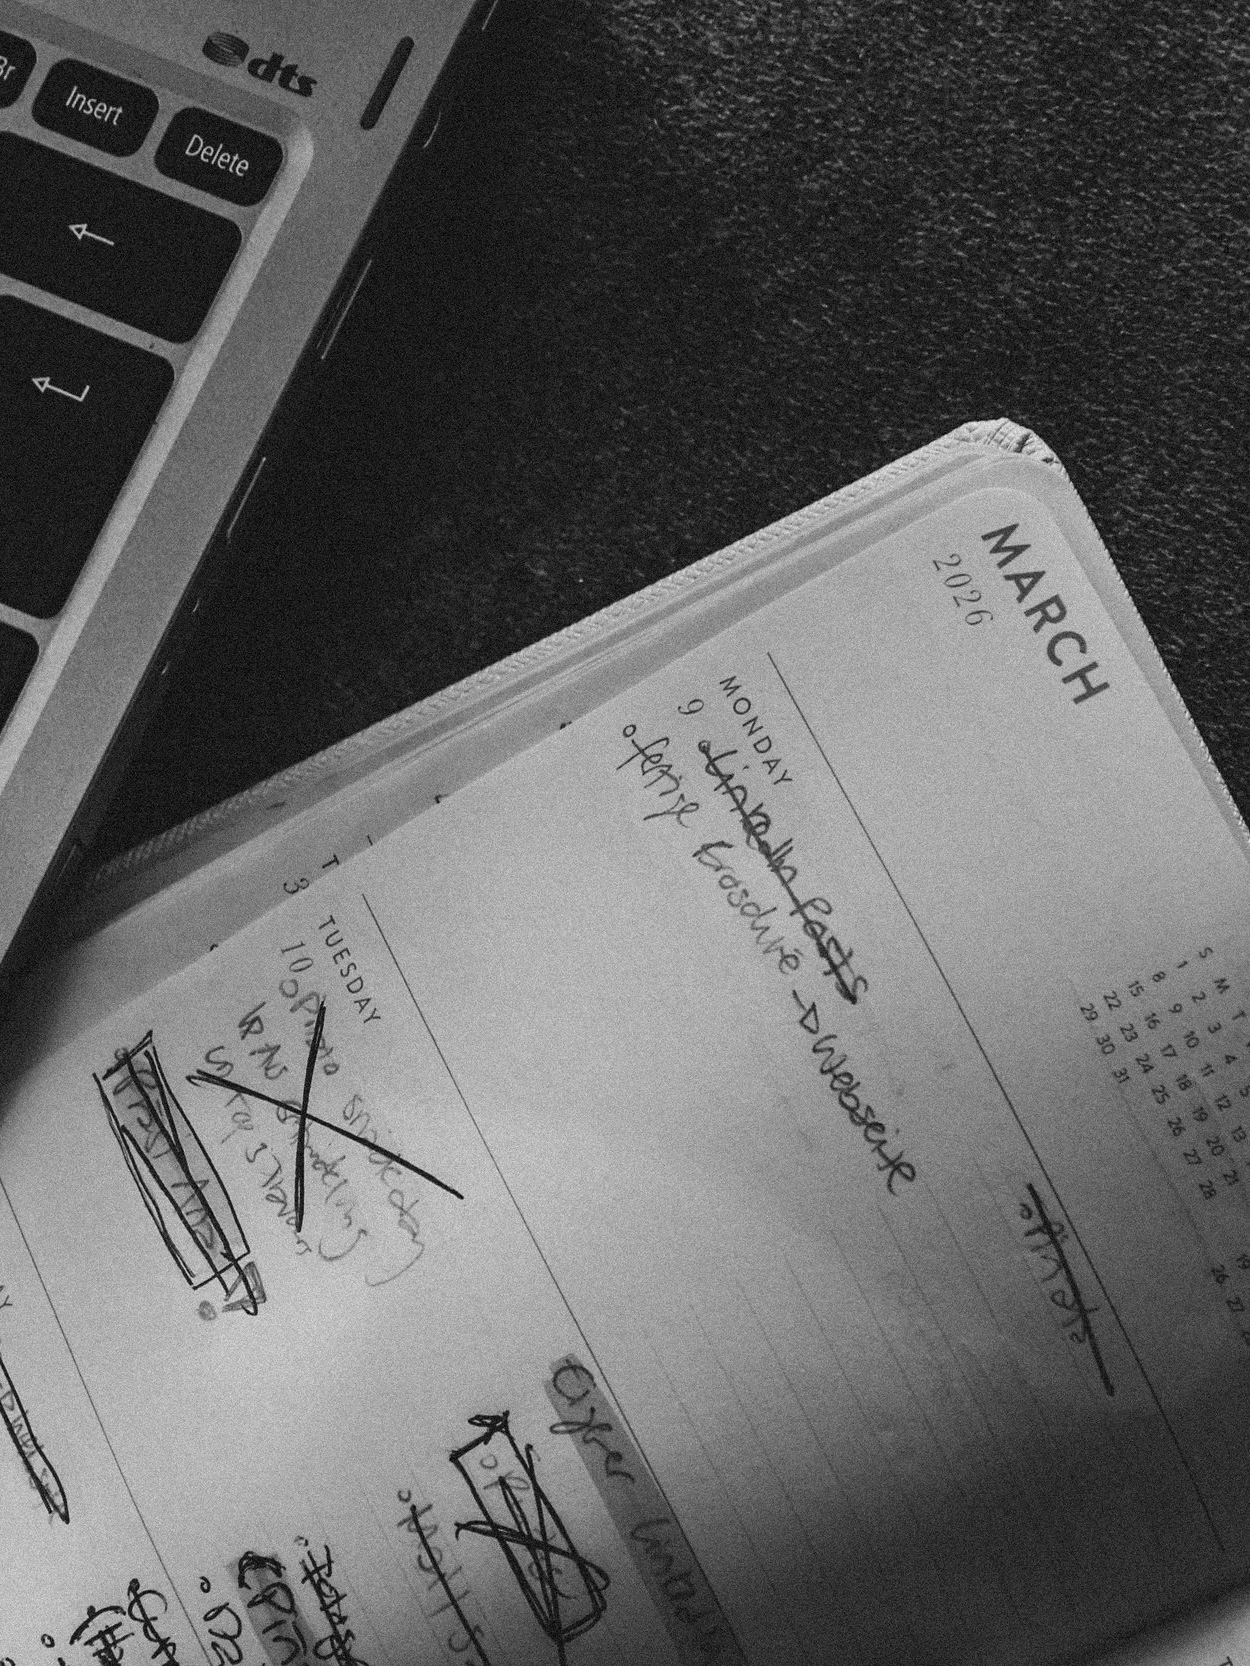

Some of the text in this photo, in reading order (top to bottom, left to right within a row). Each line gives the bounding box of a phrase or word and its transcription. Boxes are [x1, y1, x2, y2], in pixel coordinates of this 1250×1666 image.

[66, 86, 123, 125] Insert
[246, 50, 318, 98] dts
[185, 134, 249, 176] Delete
[933, 554, 989, 626] 2026
[981, 523, 1110, 704] MARCH
[678, 698, 703, 715] 9
[719, 676, 792, 785] MONDAY
[281, 942, 312, 973] 10
[319, 915, 381, 1023] TUESDAY
[1199, 947, 1246, 1019] S M T
[1080, 1004, 1130, 1084] 29 30 31
[1152, 971, 1247, 1142] 8 9 10 11 12 13
[1192, 992, 1206, 1002] 2
[1208, 1023, 1222, 1034] 3
[1224, 1055, 1237, 1065] 4
[1103, 992, 1217, 1200] 22 23 24 25 26 27 28
[1129, 981, 1240, 1186] 15 16 17 18 19 20 21
[1210, 1263, 1231, 1287] 26
